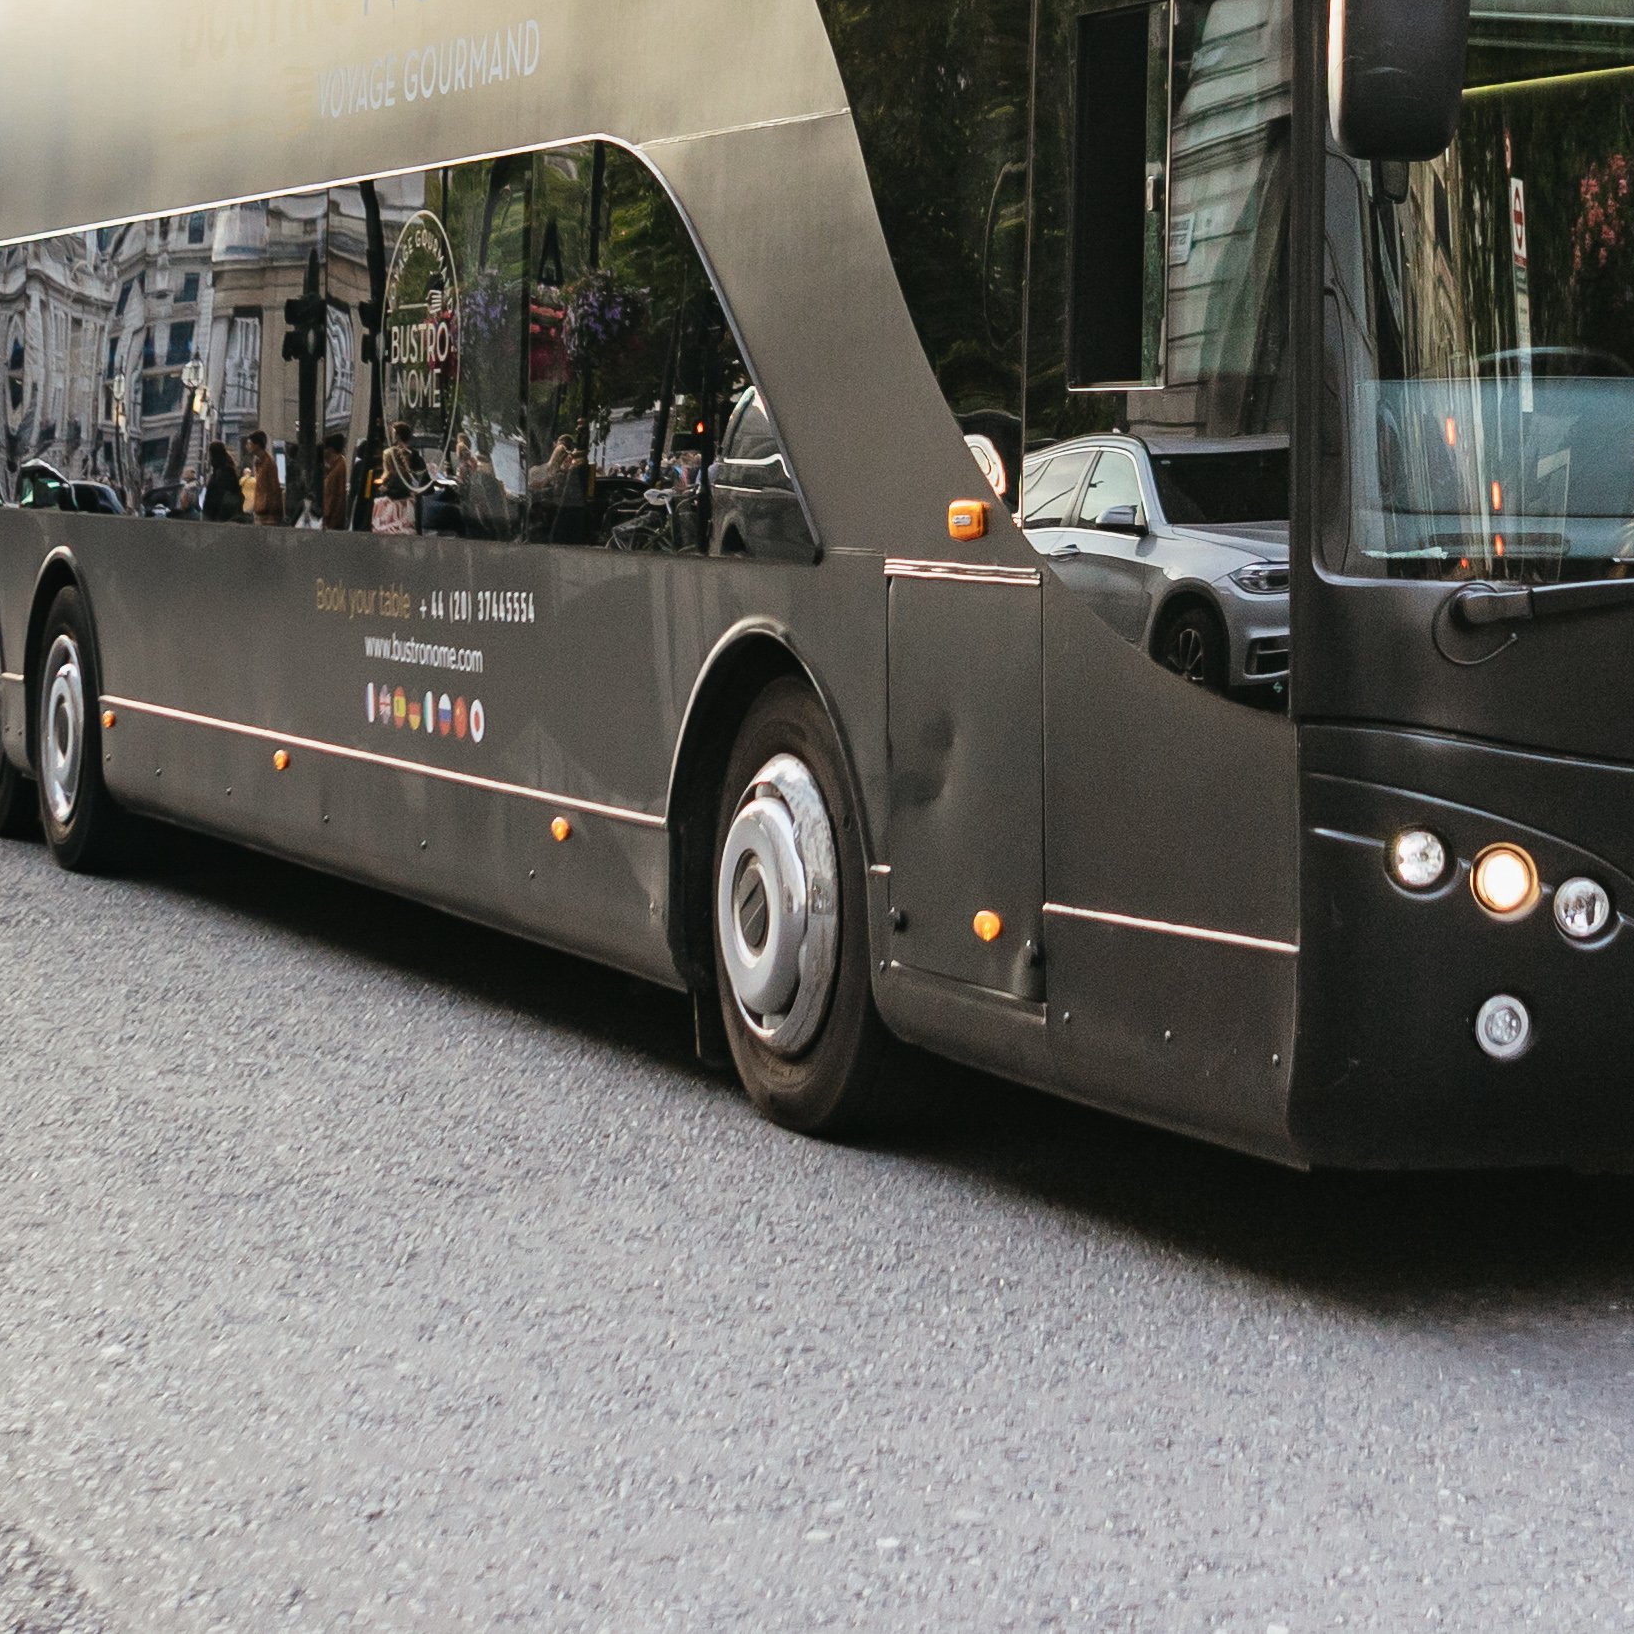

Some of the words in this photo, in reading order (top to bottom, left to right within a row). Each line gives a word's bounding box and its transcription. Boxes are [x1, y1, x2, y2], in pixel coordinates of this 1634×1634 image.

[318, 53, 396, 117] VOYAGE
[404, 19, 539, 102] GOURMAND
[391, 322, 449, 365] BUSTRO
[396, 369, 441, 409] NOME
[317, 577, 345, 612] Book
[349, 589, 376, 620] your
[379, 582, 411, 620] table
[449, 591, 472, 624] (20)
[477, 590, 535, 623] 37445554
[364, 632, 484, 673] www.bustronome.com
